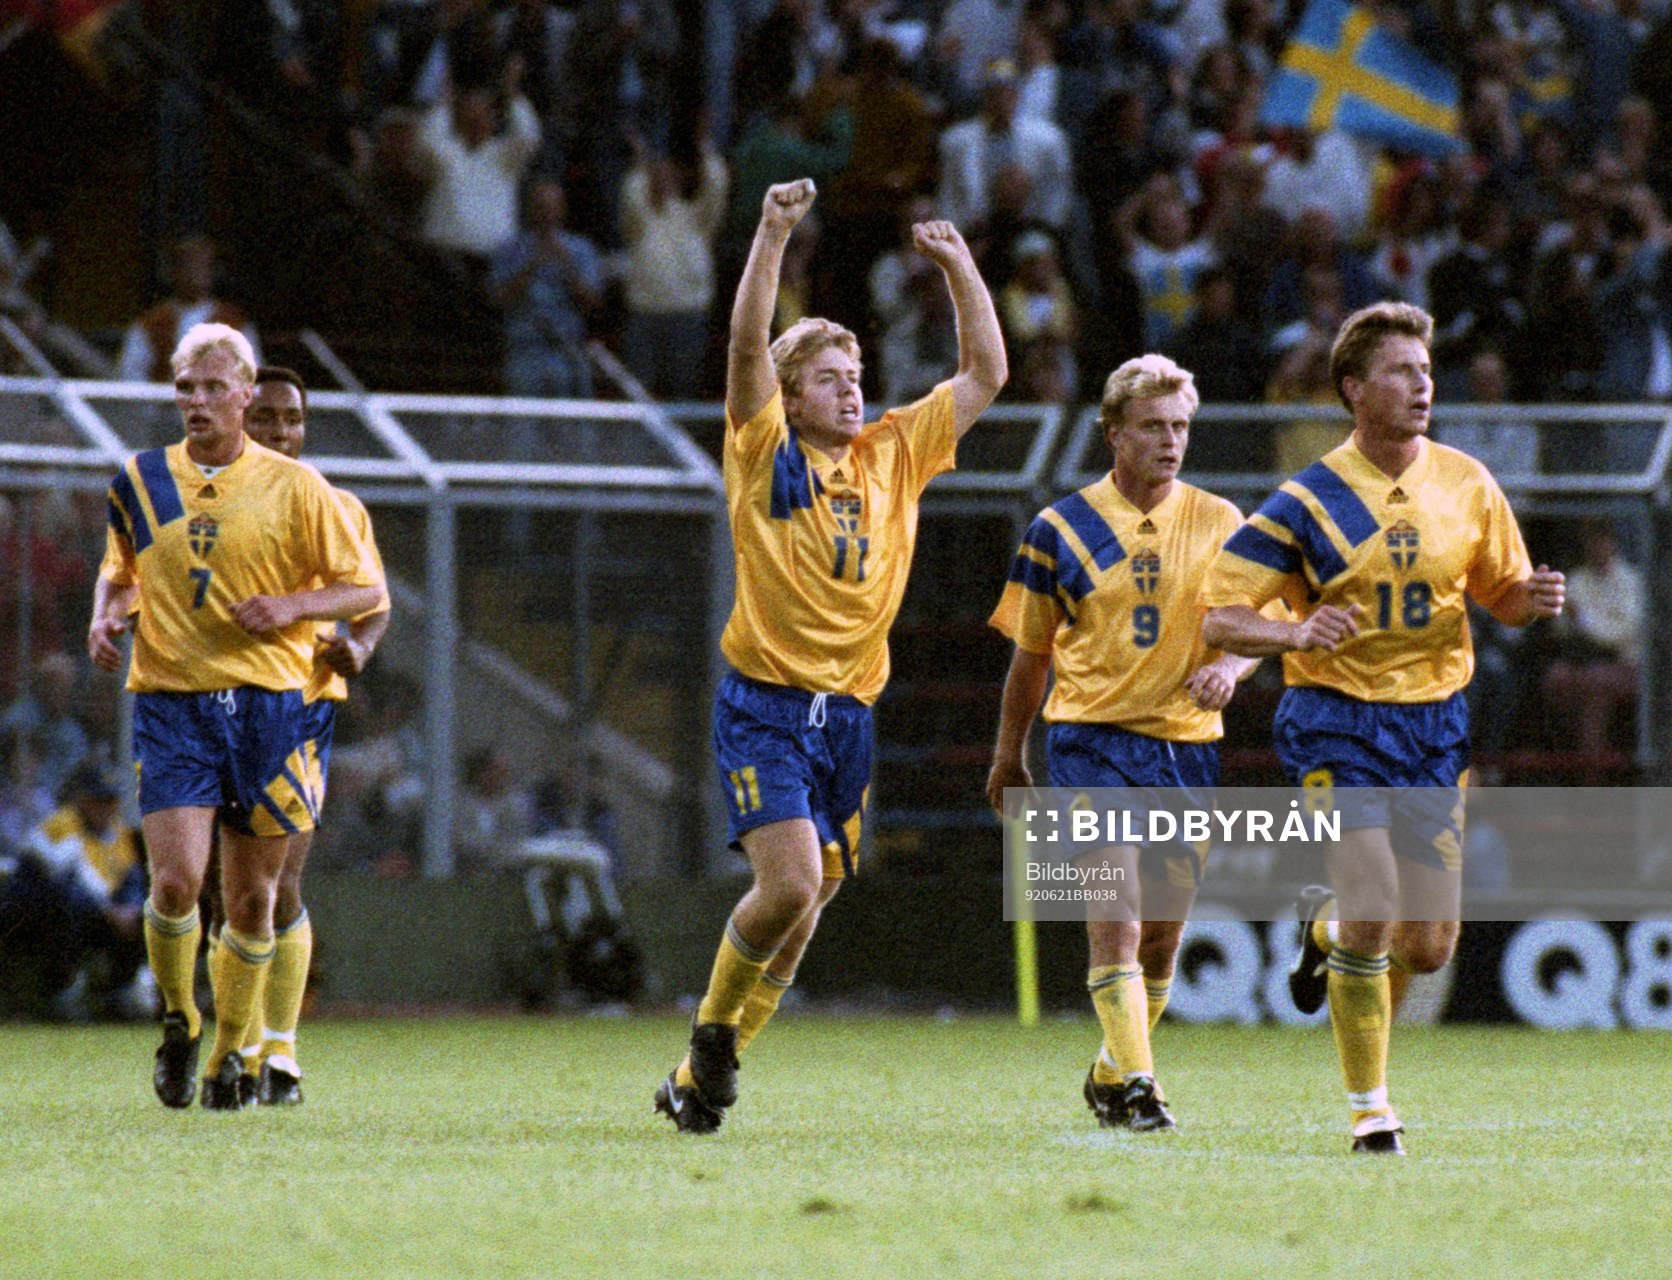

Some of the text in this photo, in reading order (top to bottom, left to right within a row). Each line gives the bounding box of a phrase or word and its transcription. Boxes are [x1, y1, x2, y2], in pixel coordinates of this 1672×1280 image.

[831, 535, 869, 582] 11
[189, 568, 211, 609] 7
[1376, 580, 1433, 629] 18
[1132, 604, 1160, 649] 9
[729, 766, 762, 815] 11
